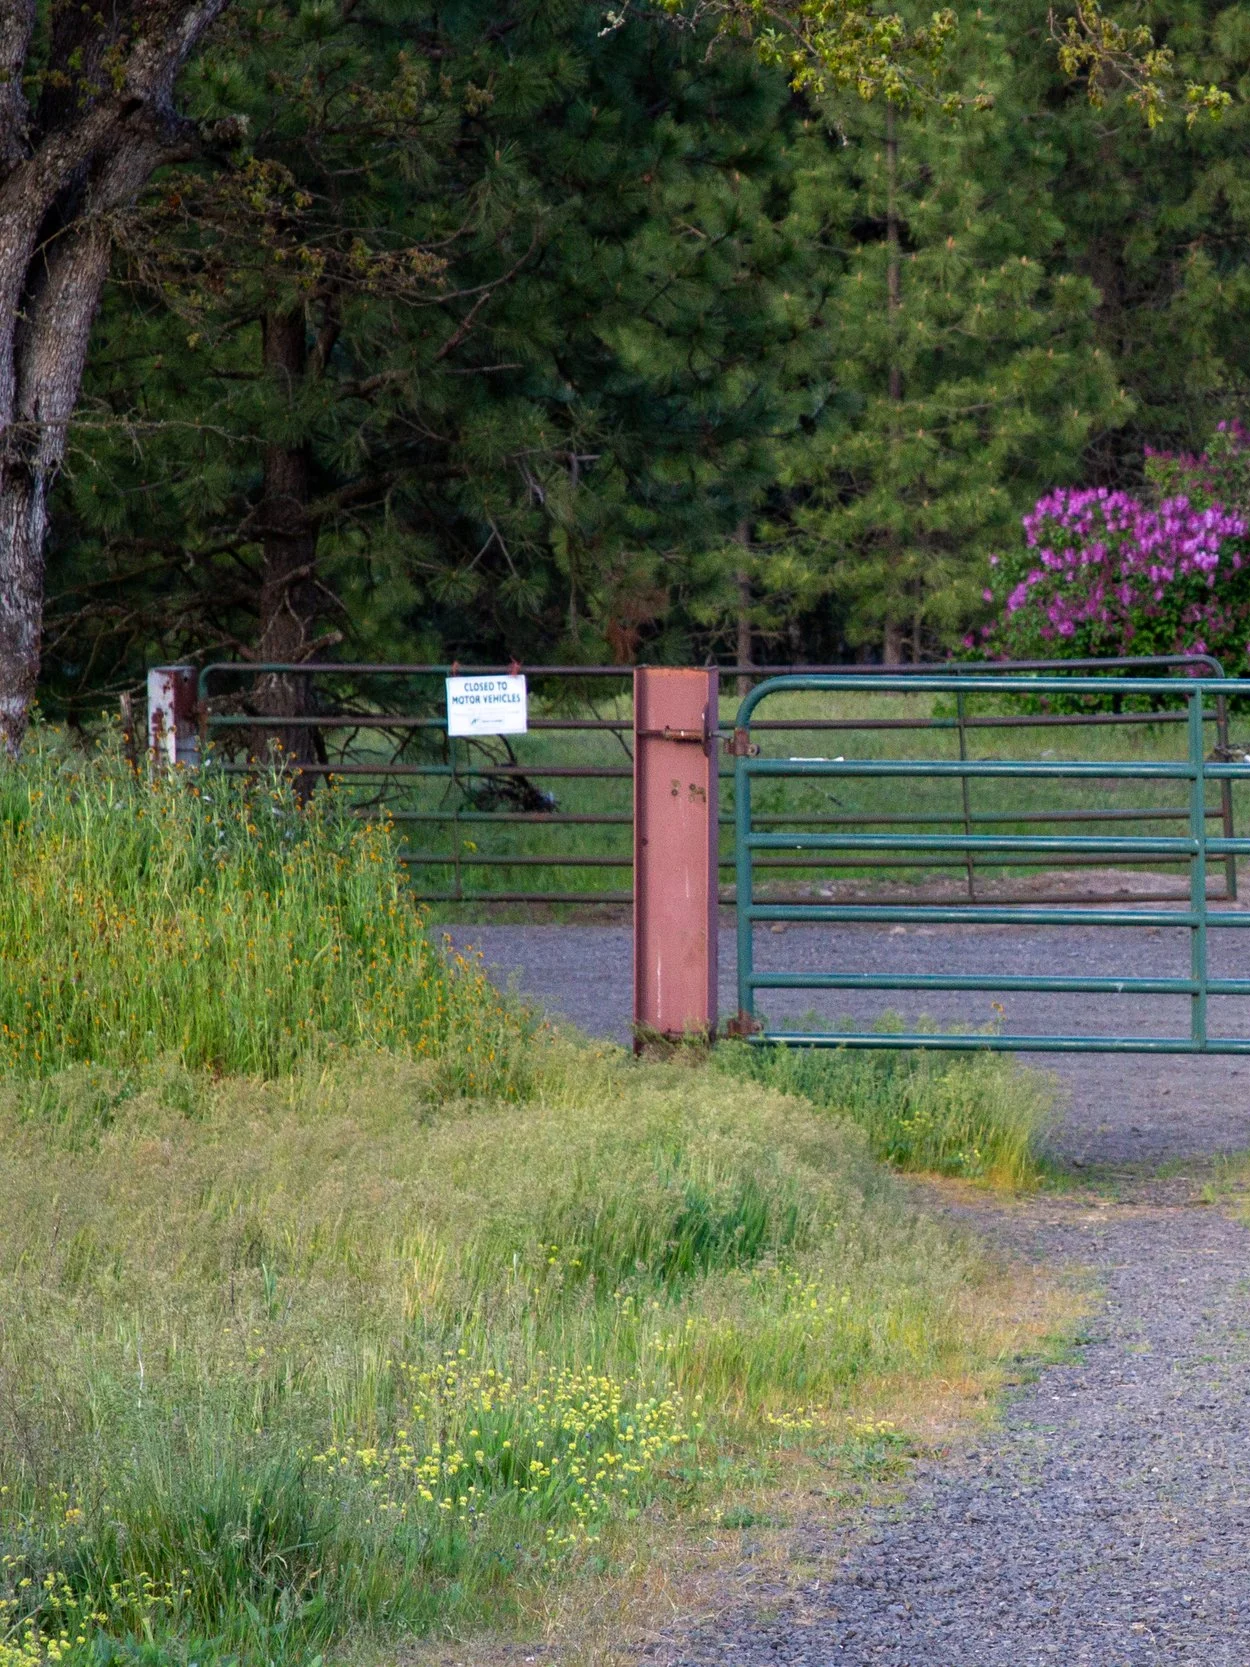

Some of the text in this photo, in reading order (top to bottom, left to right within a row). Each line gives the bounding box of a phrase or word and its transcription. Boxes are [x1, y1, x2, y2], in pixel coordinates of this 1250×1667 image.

[464, 681, 508, 692] CLOSED TO
[452, 693, 521, 705] MOTOR VEHICLES
